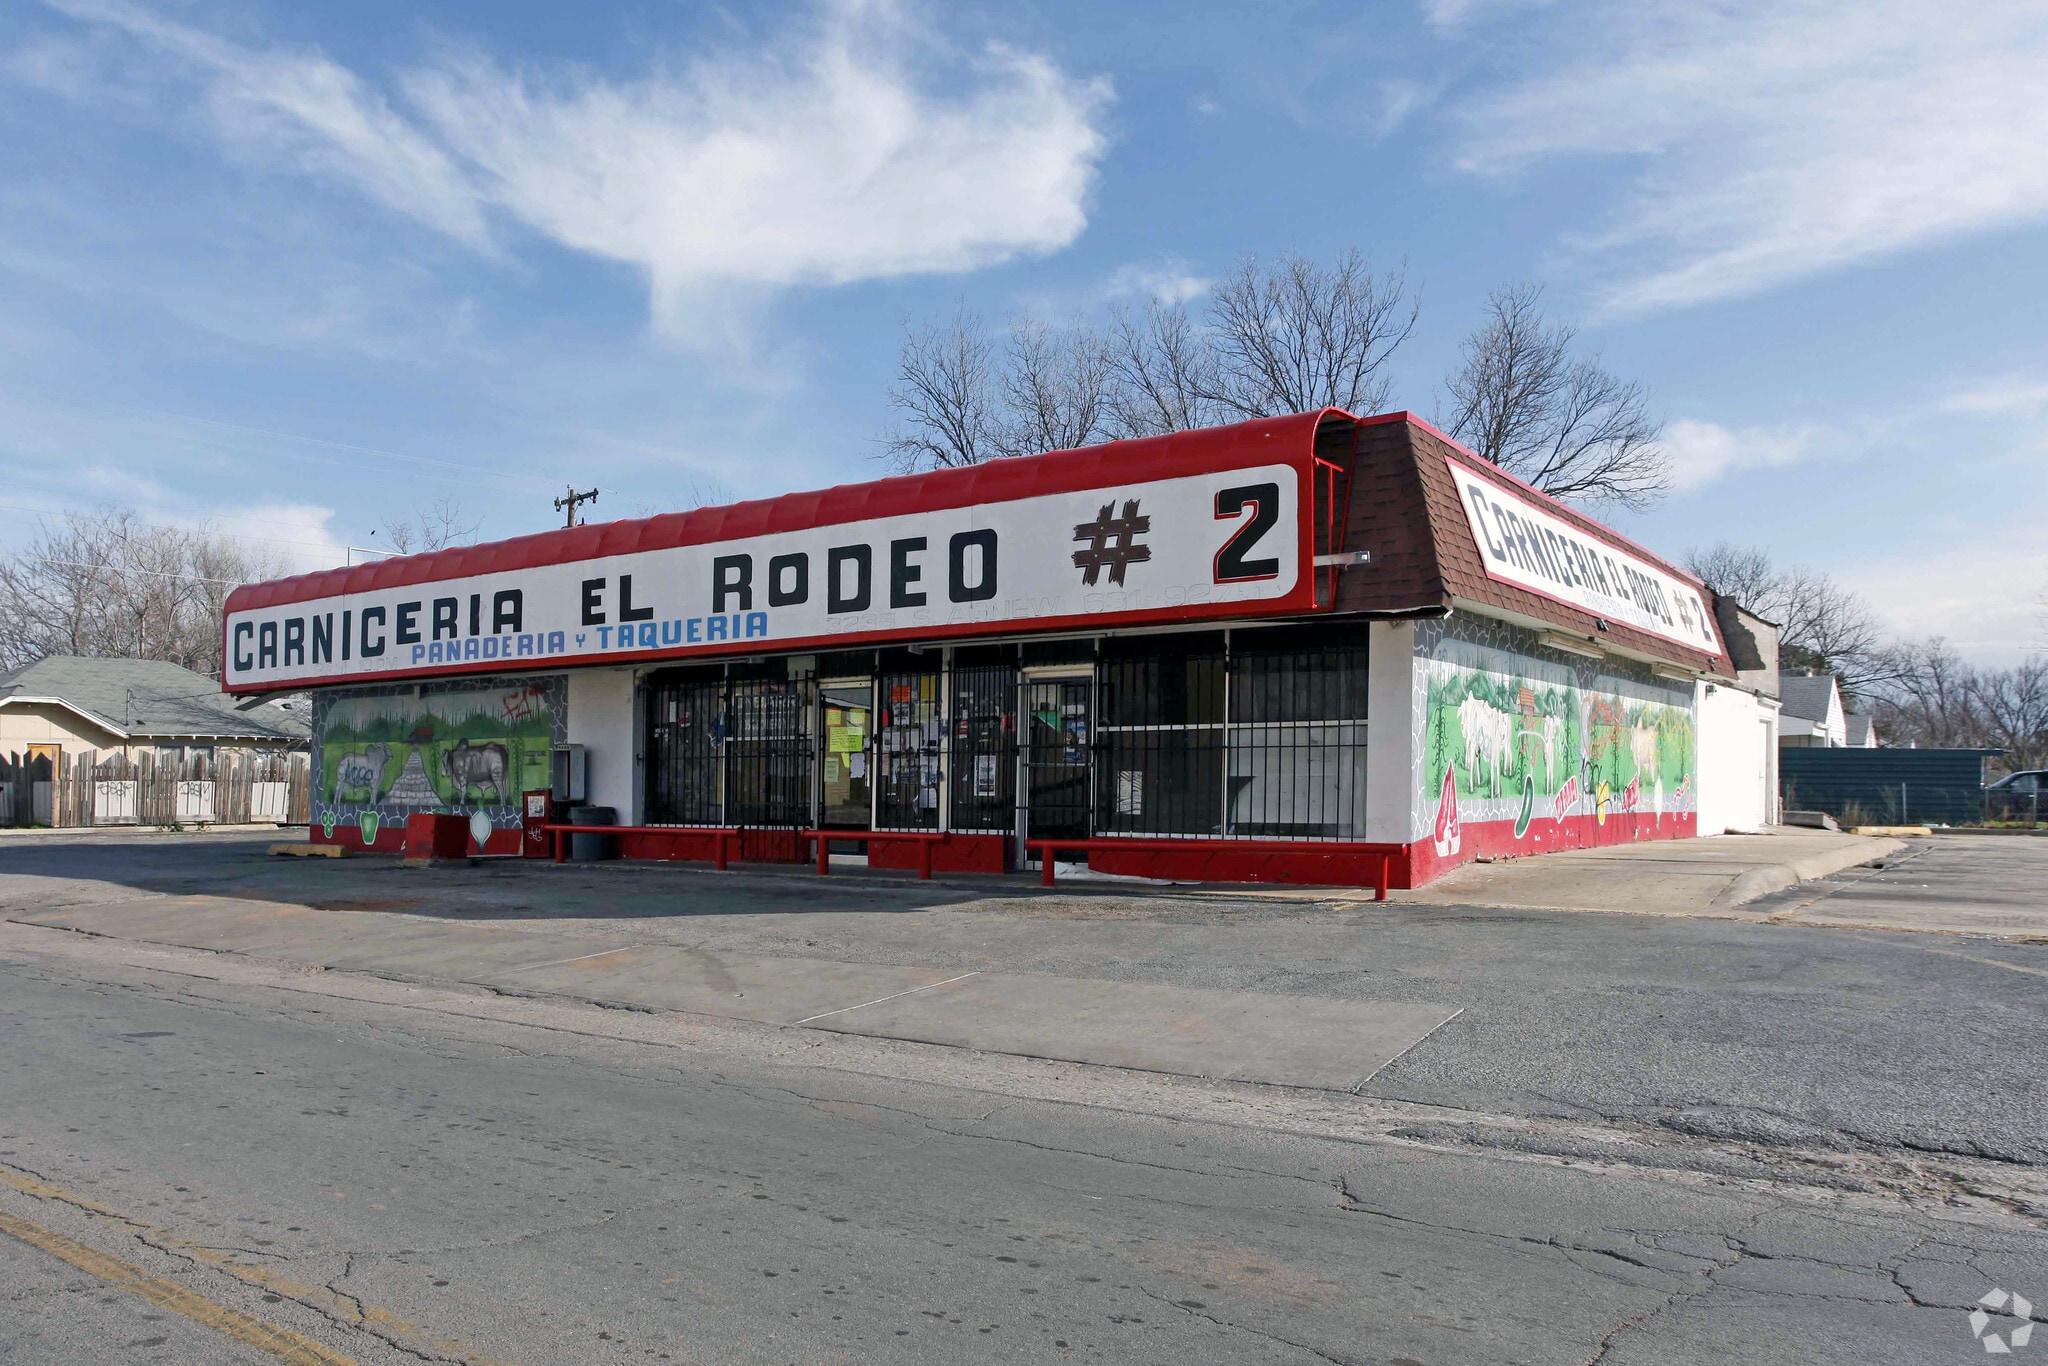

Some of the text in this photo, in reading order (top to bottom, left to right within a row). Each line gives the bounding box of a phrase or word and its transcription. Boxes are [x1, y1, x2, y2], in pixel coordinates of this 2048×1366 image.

[233, 482, 1280, 672] CARNICERIA EL RODEO # 2
[1467, 484, 1612, 597] CARNICERIA
[1604, 555, 1631, 600] EL
[1622, 563, 1674, 627] RODEO
[412, 611, 768, 665] PANADERIA Y TAQUERIA
